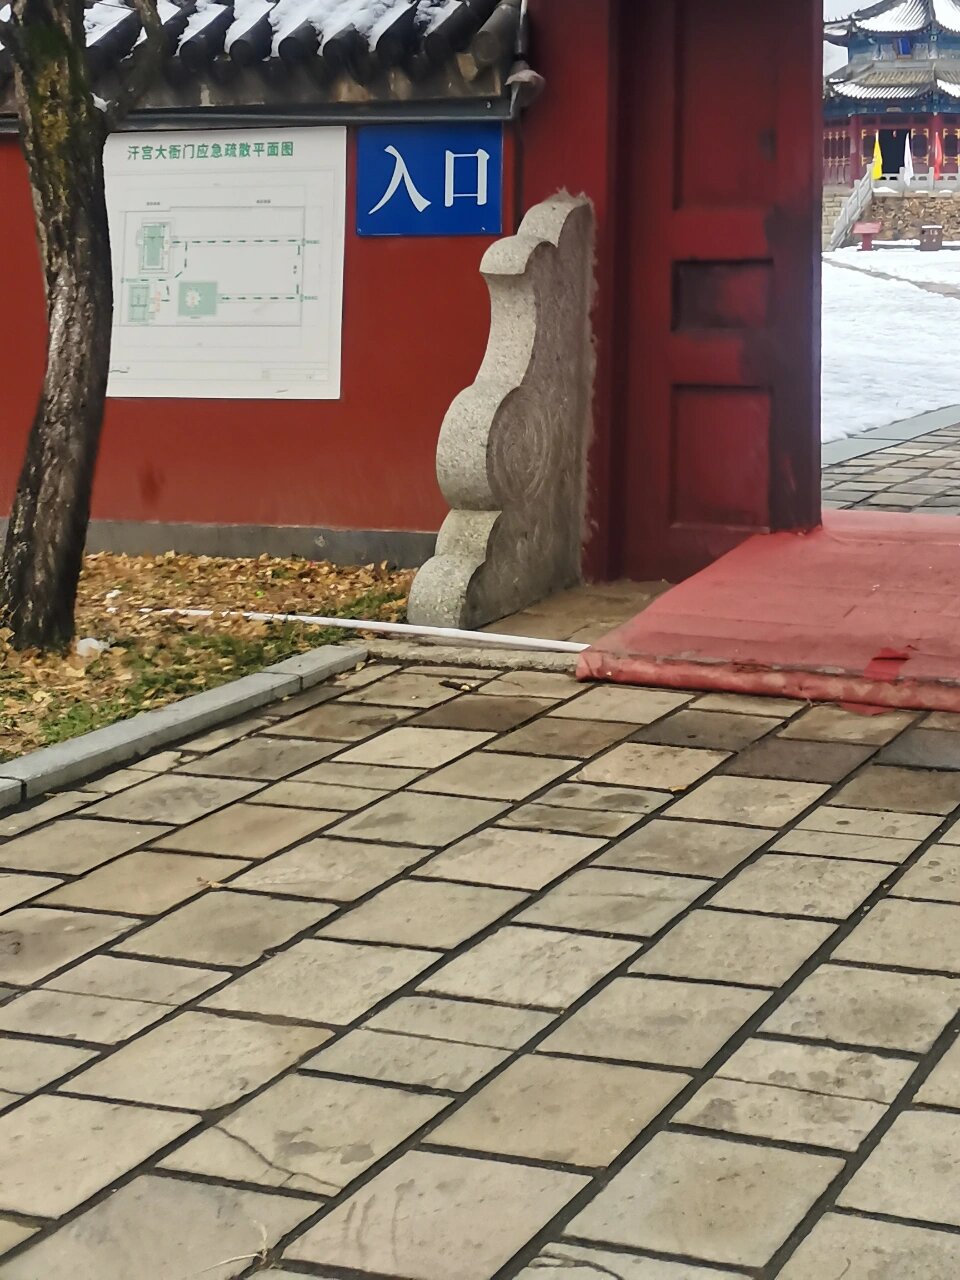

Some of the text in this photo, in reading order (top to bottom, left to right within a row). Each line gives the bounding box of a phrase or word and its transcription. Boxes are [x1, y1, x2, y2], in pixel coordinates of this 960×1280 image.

[127, 141, 294, 160] 汗宫大衙门应急疏散平面图
[368, 145, 490, 215] 入口
